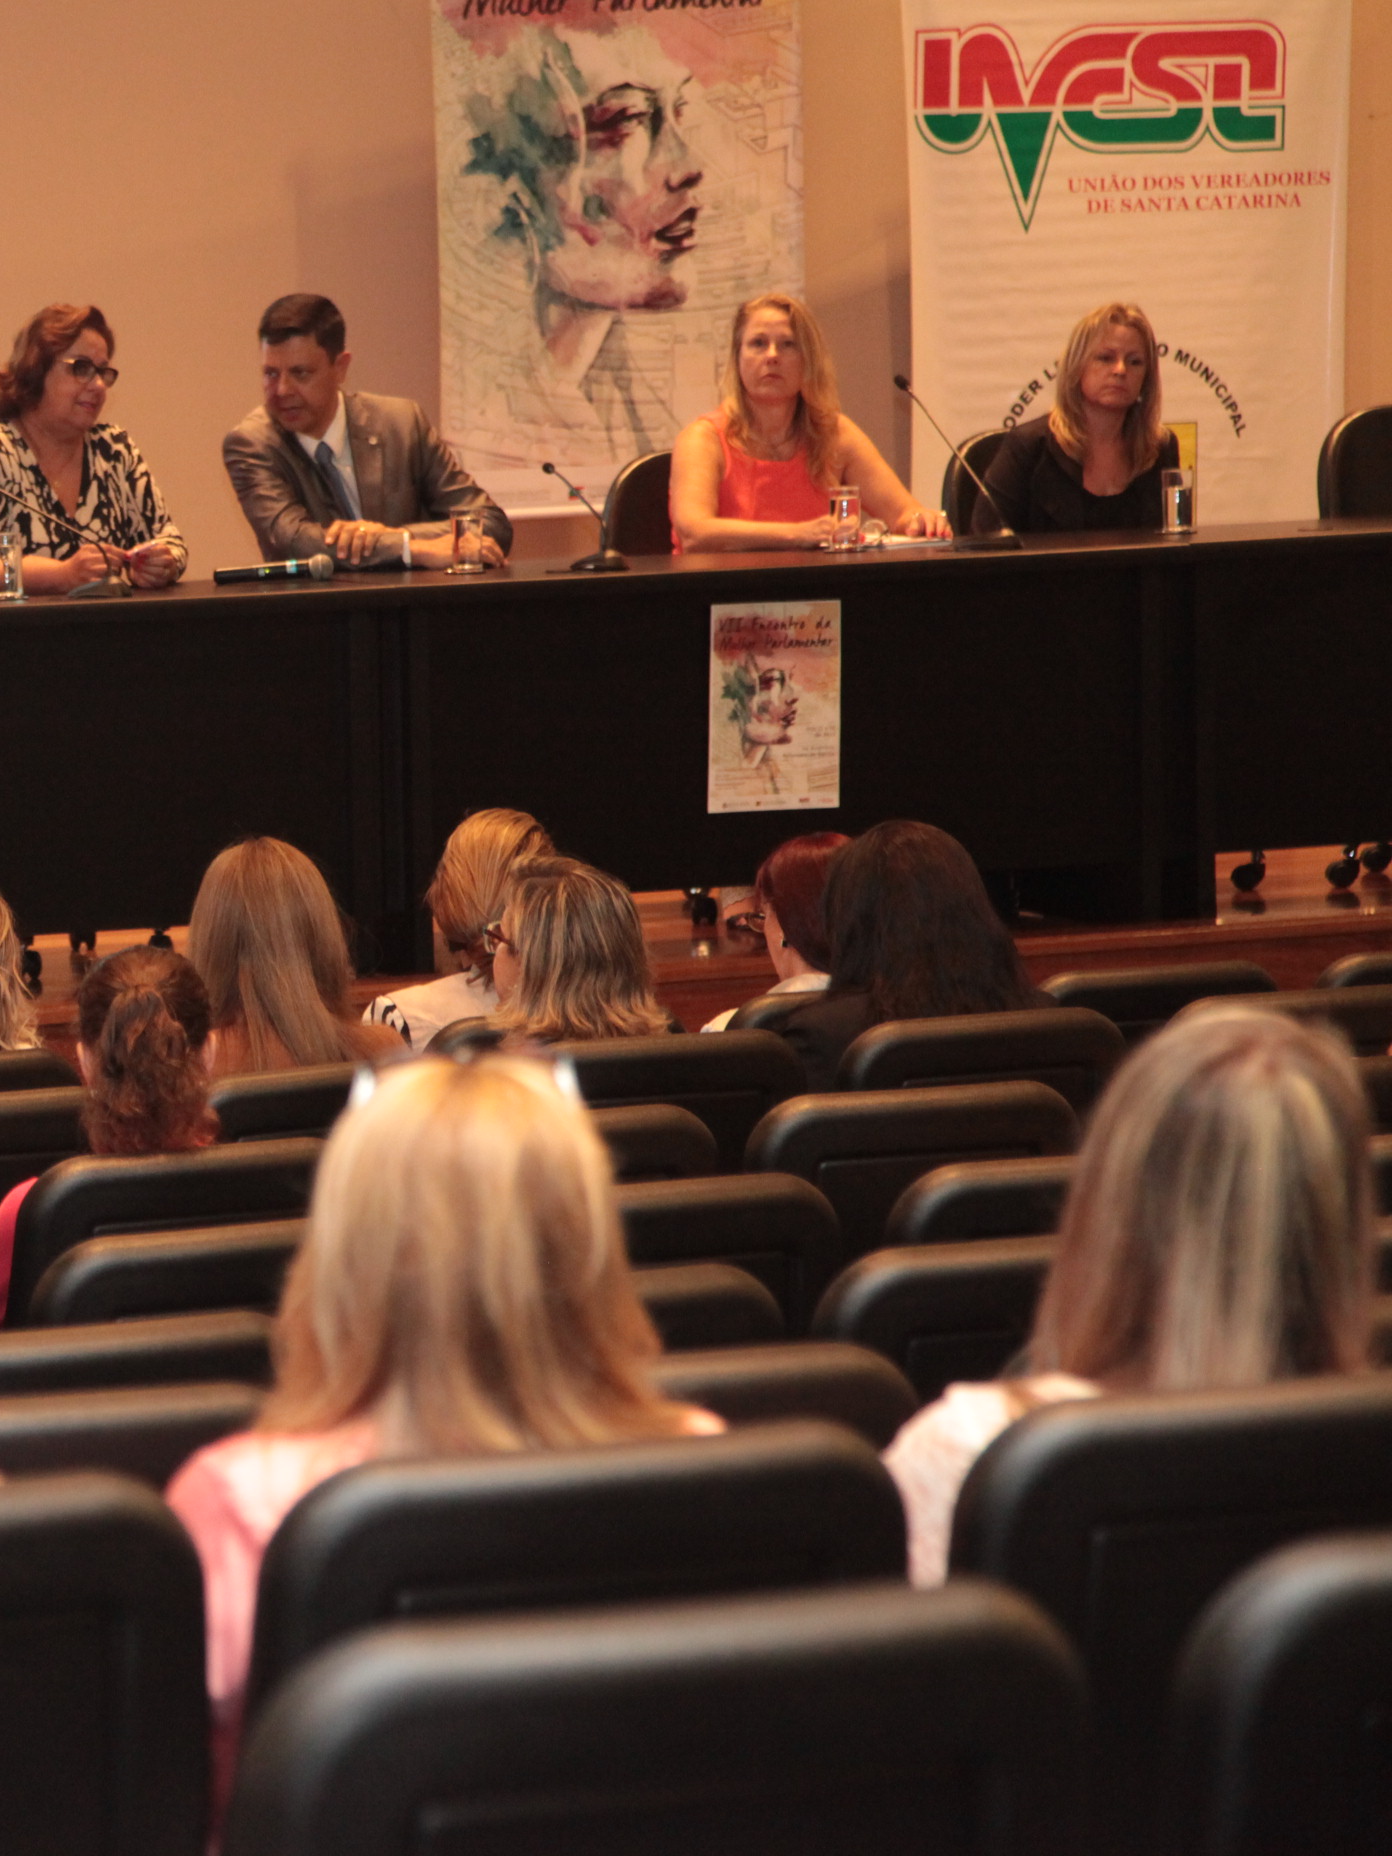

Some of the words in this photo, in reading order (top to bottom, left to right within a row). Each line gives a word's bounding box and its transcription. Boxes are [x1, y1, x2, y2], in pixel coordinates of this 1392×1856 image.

[1067, 174, 1136, 194] UNIÃO
[1143, 174, 1185, 192] DOS
[1190, 170, 1332, 189] VEREADORES
[1086, 197, 1116, 214] DE
[1119, 195, 1189, 213] SANTA
[1195, 192, 1302, 211] CATARINA
[1002, 379, 1043, 431] ODER
[1173, 348, 1248, 439] MUNICIPAL
[815, 615, 832, 629] da
